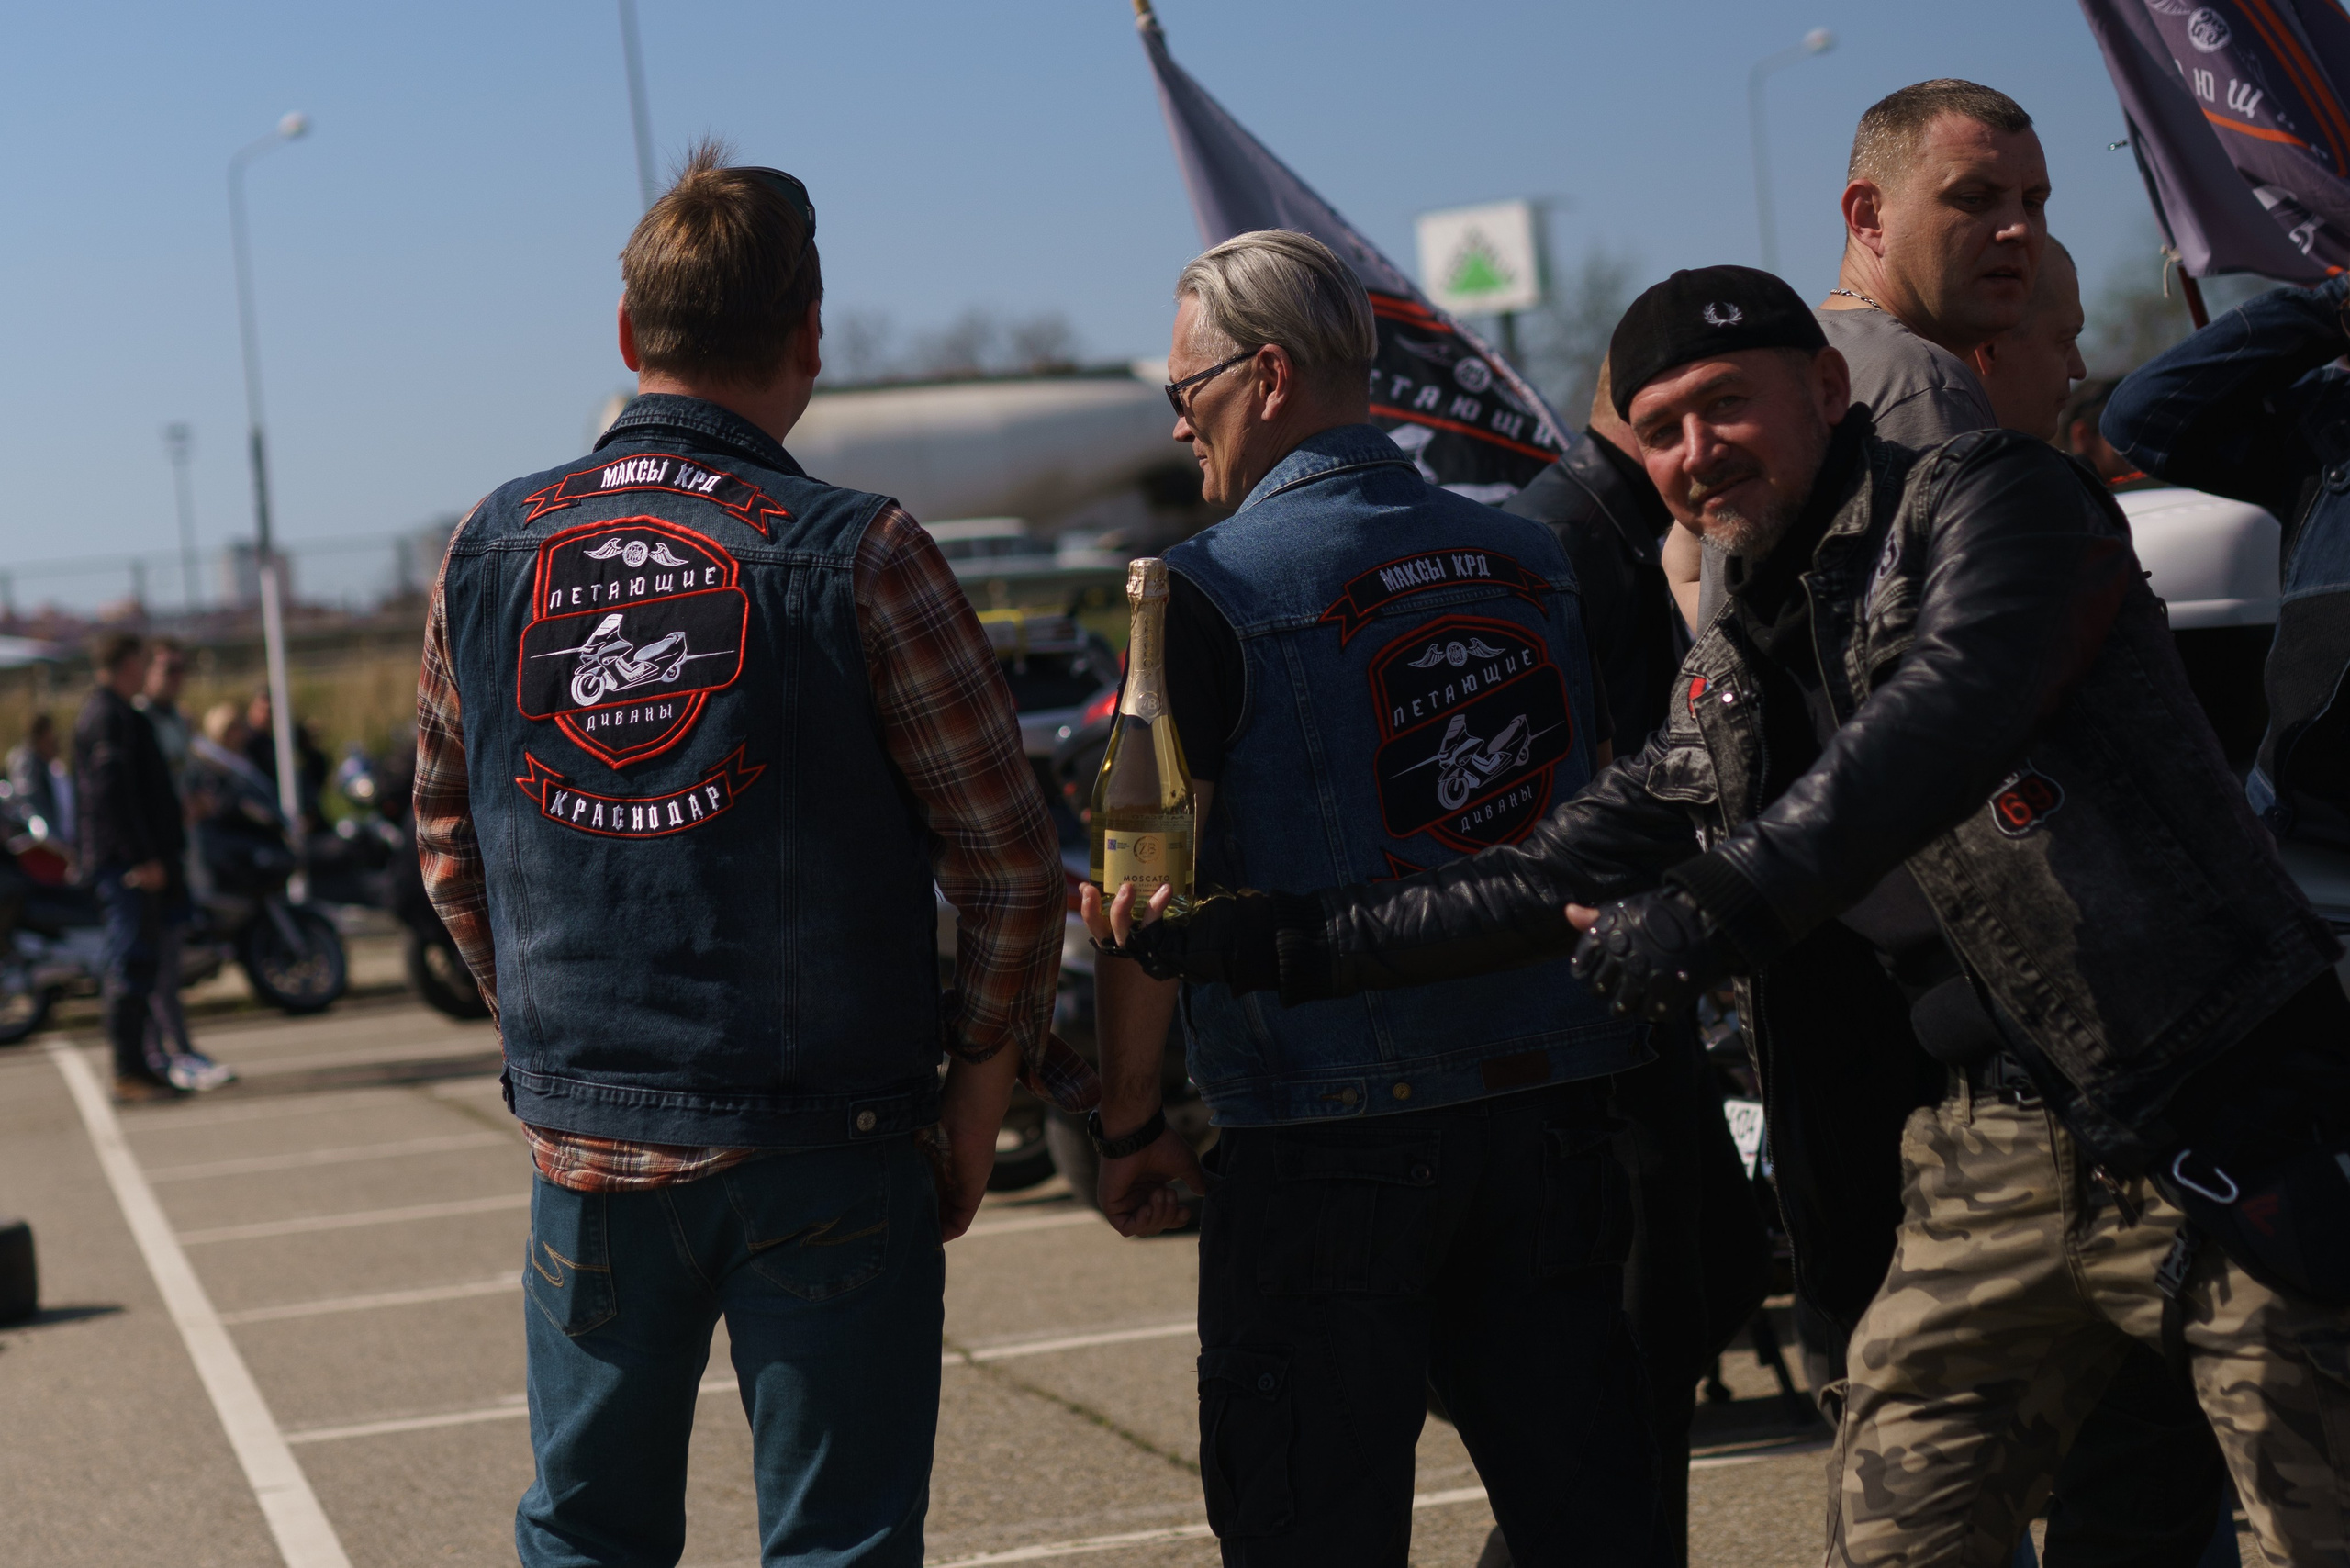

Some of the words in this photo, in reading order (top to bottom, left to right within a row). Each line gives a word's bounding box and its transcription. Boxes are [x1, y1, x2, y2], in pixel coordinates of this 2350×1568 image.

[600, 458, 669, 488] МАКСЫ
[674, 463, 722, 494] КРД
[549, 566, 717, 610] ЛЕТАЮЩИЕ
[1379, 556, 1447, 592] МАКСЫ
[1451, 553, 1491, 578] КРД
[1393, 648, 1533, 728] ЛЕТАЮЩИЕ
[586, 703, 673, 733] ДИВАНЫ
[550, 785, 721, 832] КРАСНОДАР
[1460, 785, 1533, 834] ДИВАНЫ
[1123, 874, 1170, 882] MOSCATO
